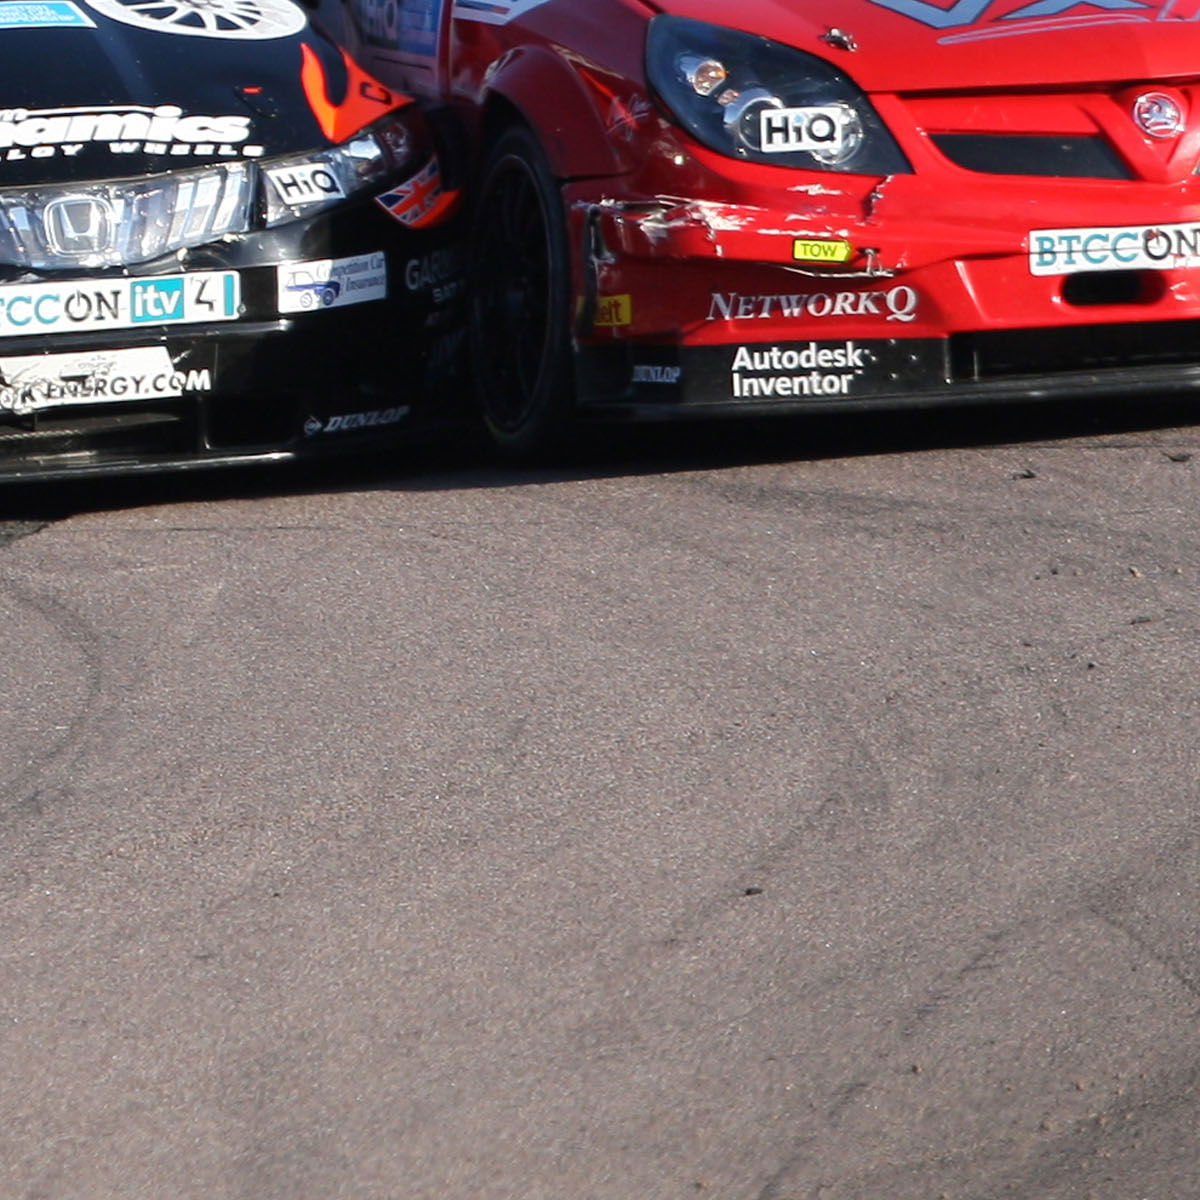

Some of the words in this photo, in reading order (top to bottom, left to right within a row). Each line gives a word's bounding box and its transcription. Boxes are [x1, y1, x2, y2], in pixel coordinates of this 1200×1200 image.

[765, 112, 836, 145] HiQ
[108, 141, 265, 157] WHEELS
[275, 169, 340, 198] HiQ
[800, 243, 838, 258] TOW
[134, 285, 181, 318] itv
[705, 291, 881, 322] NETWORK
[885, 285, 919, 322] Q
[731, 341, 864, 371] Autodesk
[733, 372, 854, 397] Inventor
[323, 405, 411, 432] DUNLOP
